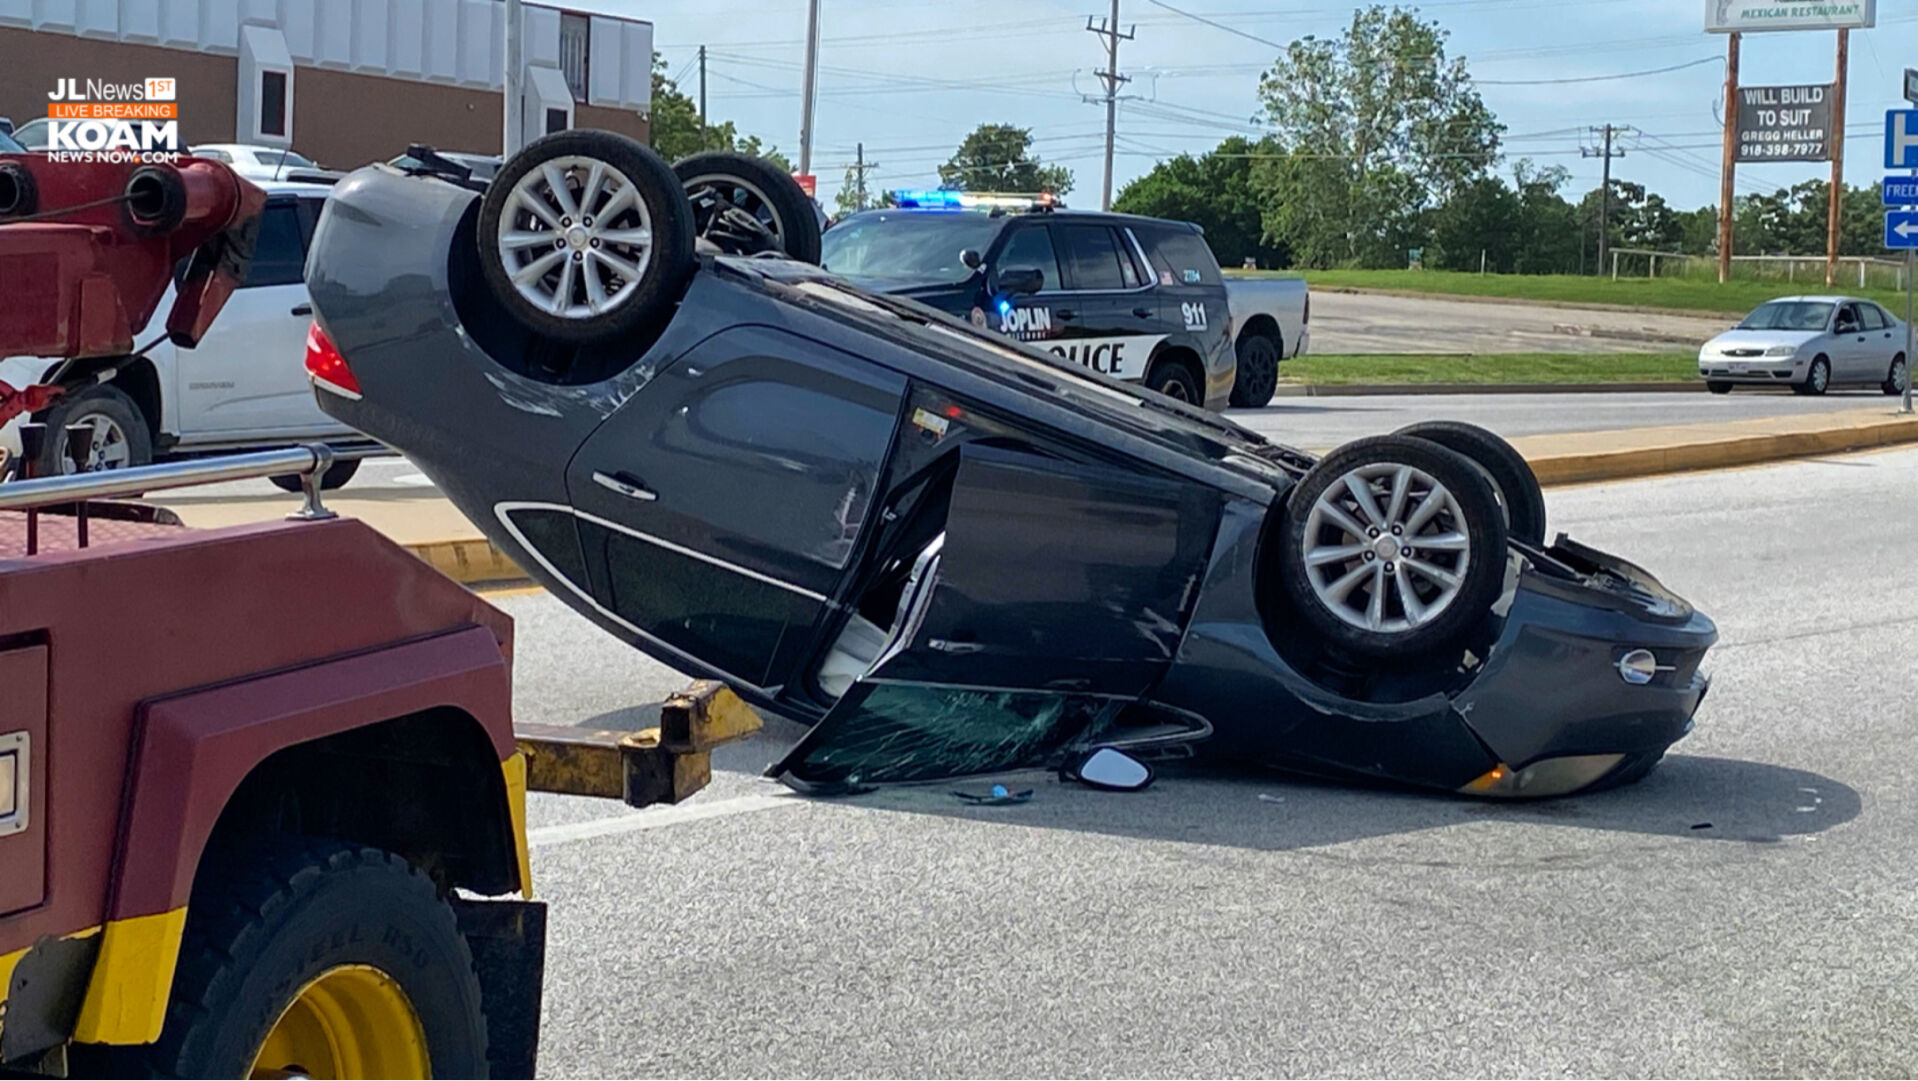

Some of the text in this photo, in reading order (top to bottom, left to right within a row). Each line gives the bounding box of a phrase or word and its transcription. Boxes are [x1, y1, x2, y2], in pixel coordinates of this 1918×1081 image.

[1741, 4, 1859, 18] MEXICAN RESTAURANT
[1744, 87, 1824, 105] WILL BUILD
[1757, 109, 1812, 126] TO SUIT
[1742, 129, 1824, 141] GREGG HELLER
[1740, 143, 1823, 156] 918-398-7977
[1000, 306, 1051, 333] JOPLIN
[1181, 302, 1207, 326] 911
